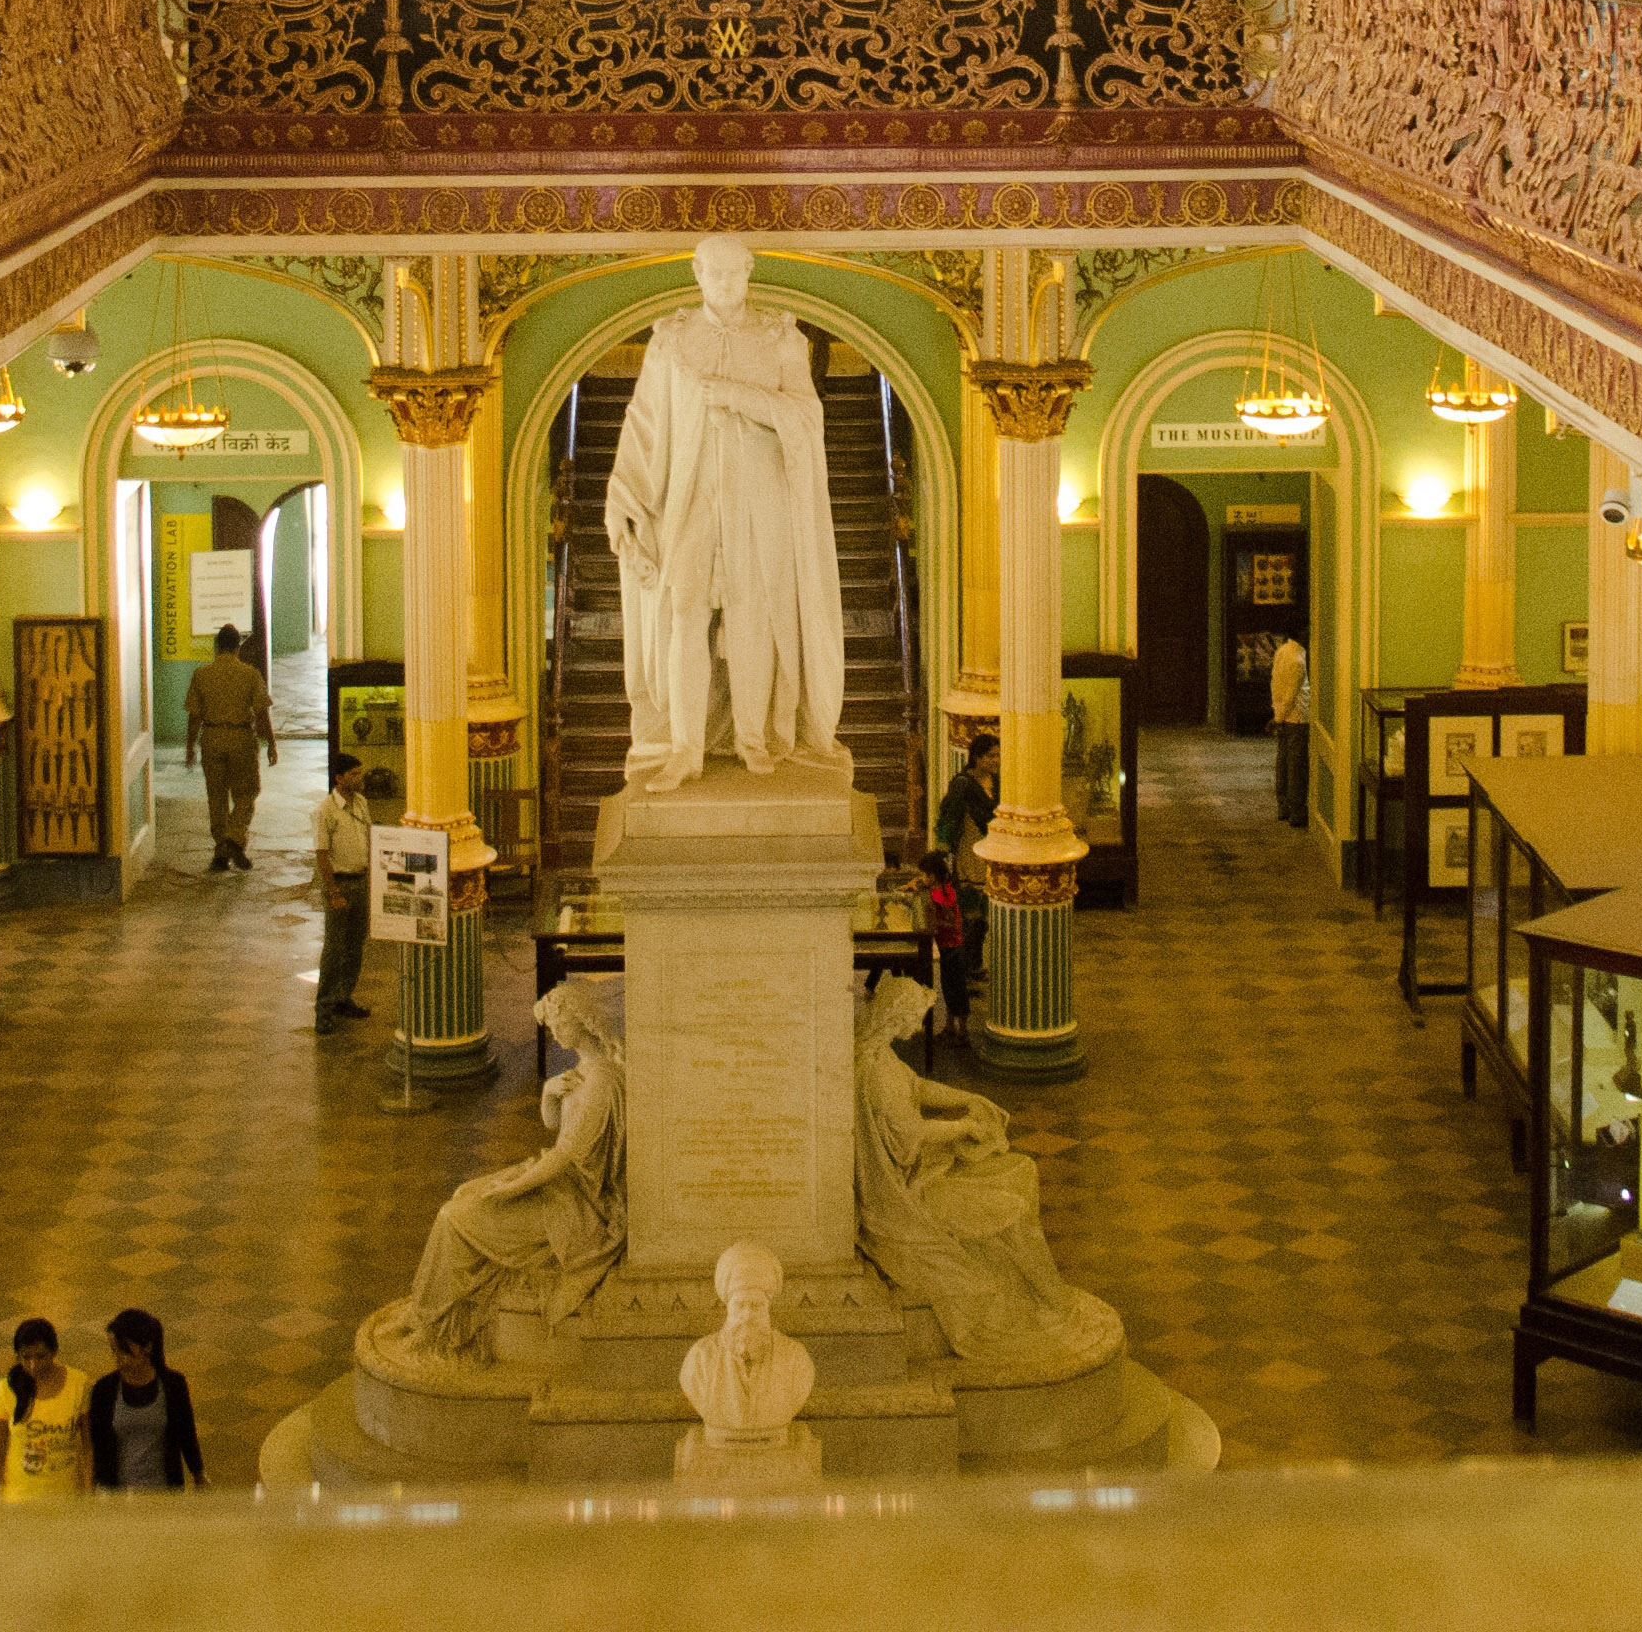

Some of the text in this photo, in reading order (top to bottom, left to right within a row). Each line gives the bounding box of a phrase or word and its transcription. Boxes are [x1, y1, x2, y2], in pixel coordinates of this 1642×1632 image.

[222, 433, 261, 451] विक्री
[1158, 429, 1321, 441] THE MUSEUM OP
[166, 520, 177, 655] CONSERVATION LAB
